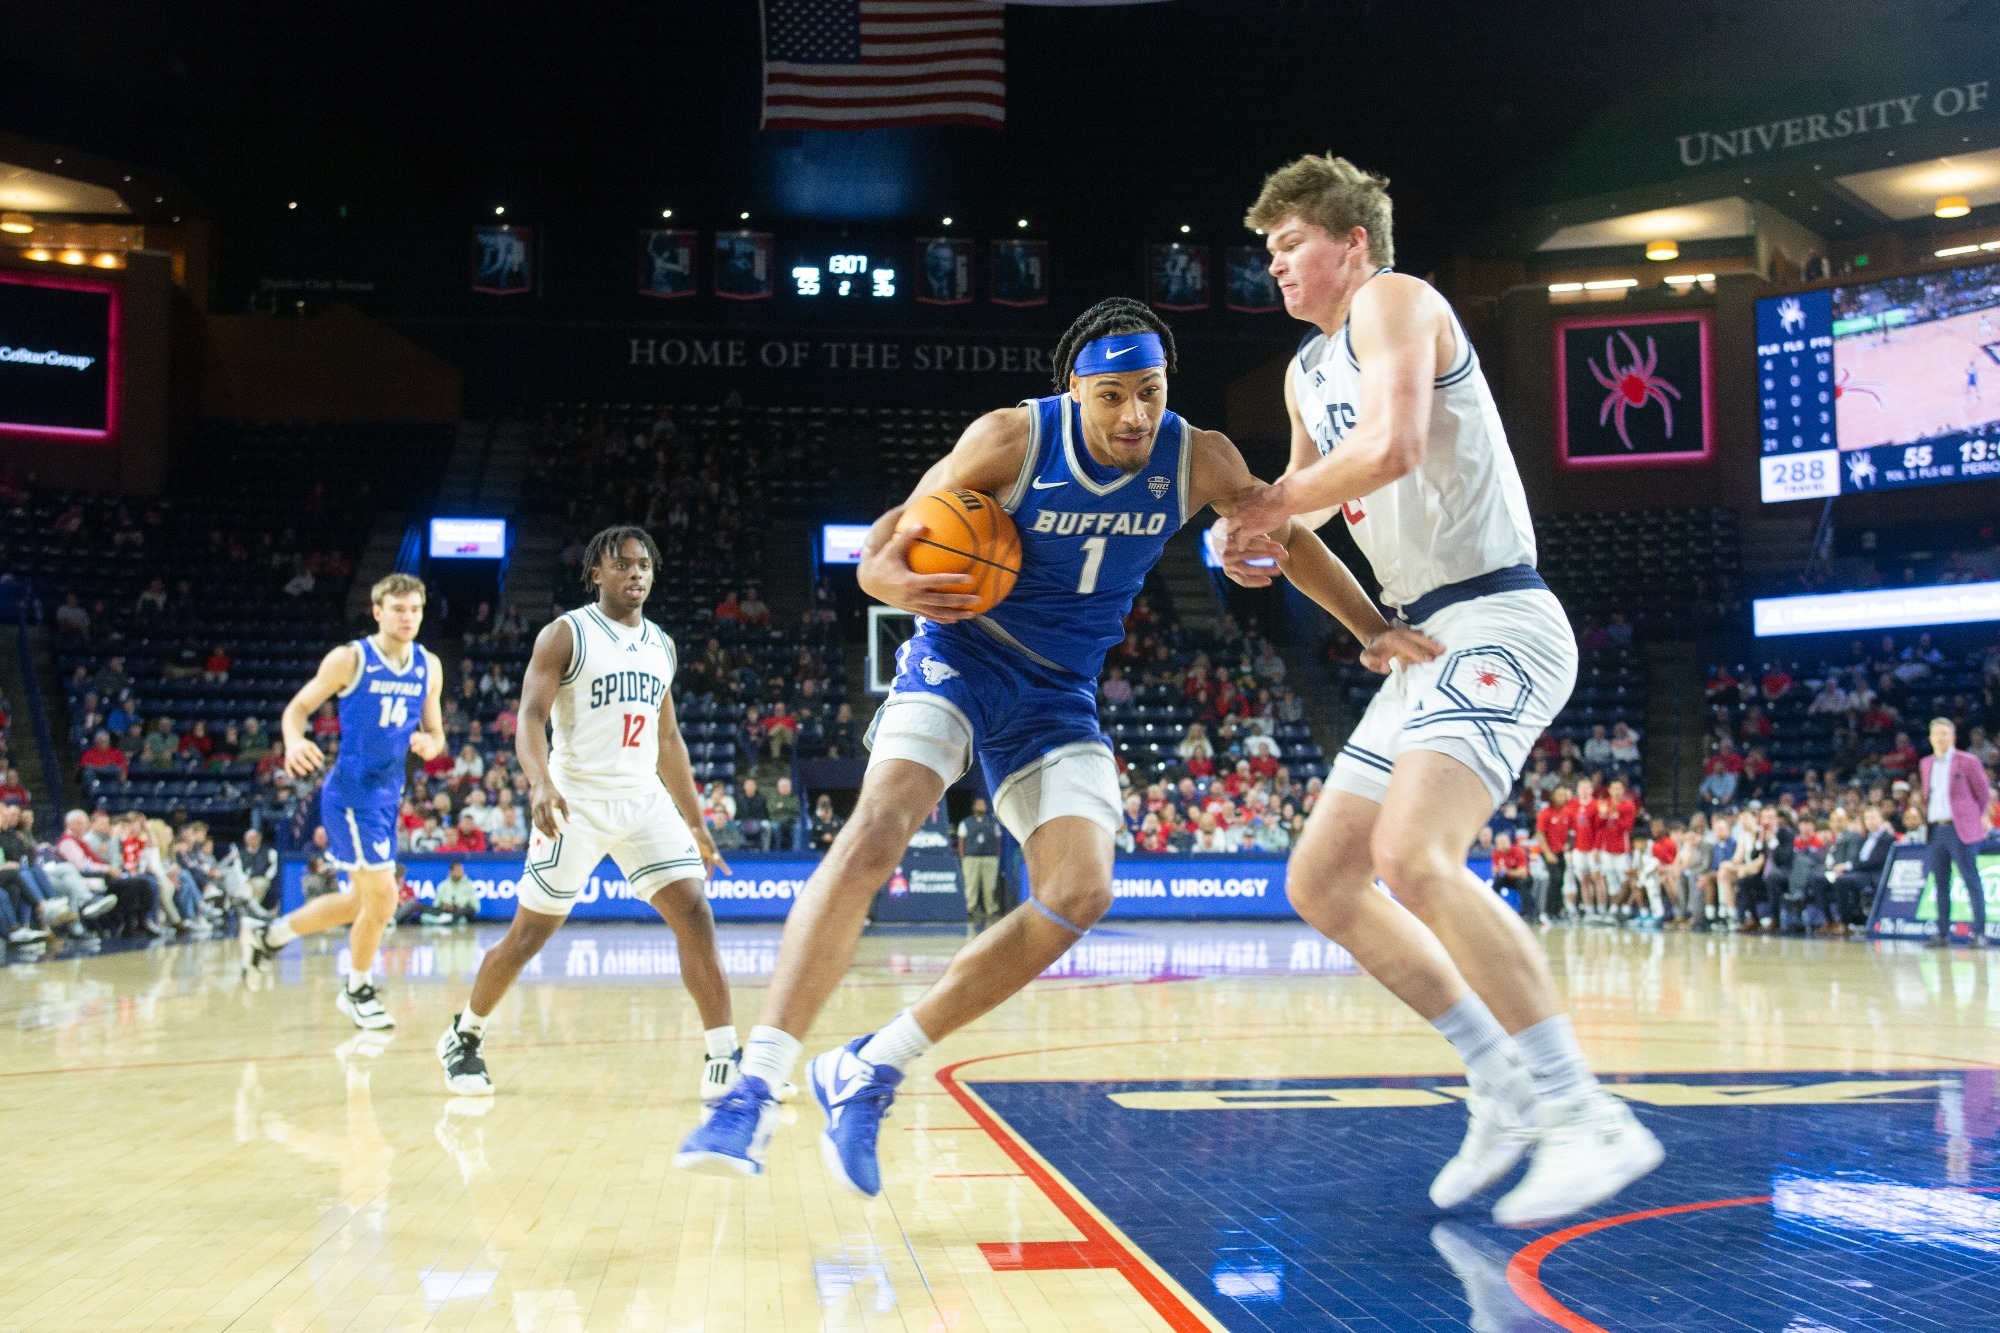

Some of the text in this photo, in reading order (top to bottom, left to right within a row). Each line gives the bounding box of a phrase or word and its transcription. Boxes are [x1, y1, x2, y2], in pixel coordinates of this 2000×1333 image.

[1676, 81, 1990, 167] UNIVERSITY OF
[629, 338, 1053, 373] HOME OF THE SPIDER
[1903, 445, 1933, 468] 55
[1959, 440, 2000, 462] 13:
[1772, 460, 1825, 484] 288
[1148, 482, 1170, 490] MAC
[1027, 509, 1168, 536] BUFFALO
[1076, 536, 1107, 595] 1
[368, 679, 422, 697] BUFFALO
[378, 696, 408, 728] 14
[622, 713, 646, 748] 12
[703, 879, 804, 899] UROLOGY
[1112, 879, 1269, 898] GINIA UROLOGY
